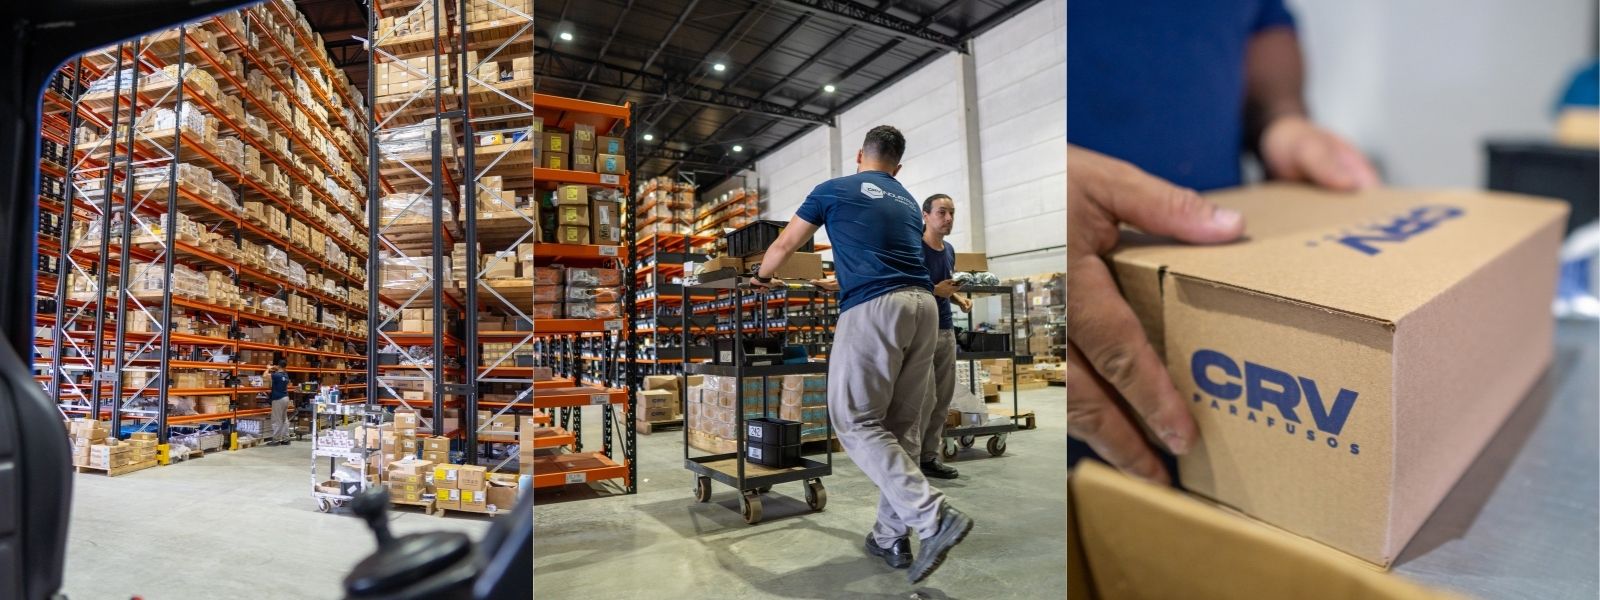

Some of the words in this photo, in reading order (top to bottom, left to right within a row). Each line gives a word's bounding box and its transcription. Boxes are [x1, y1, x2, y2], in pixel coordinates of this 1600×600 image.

[1336, 205, 1465, 256] CRV
[1190, 348, 1360, 437] CRV
[1192, 393, 1361, 456] PARAFUSOS
